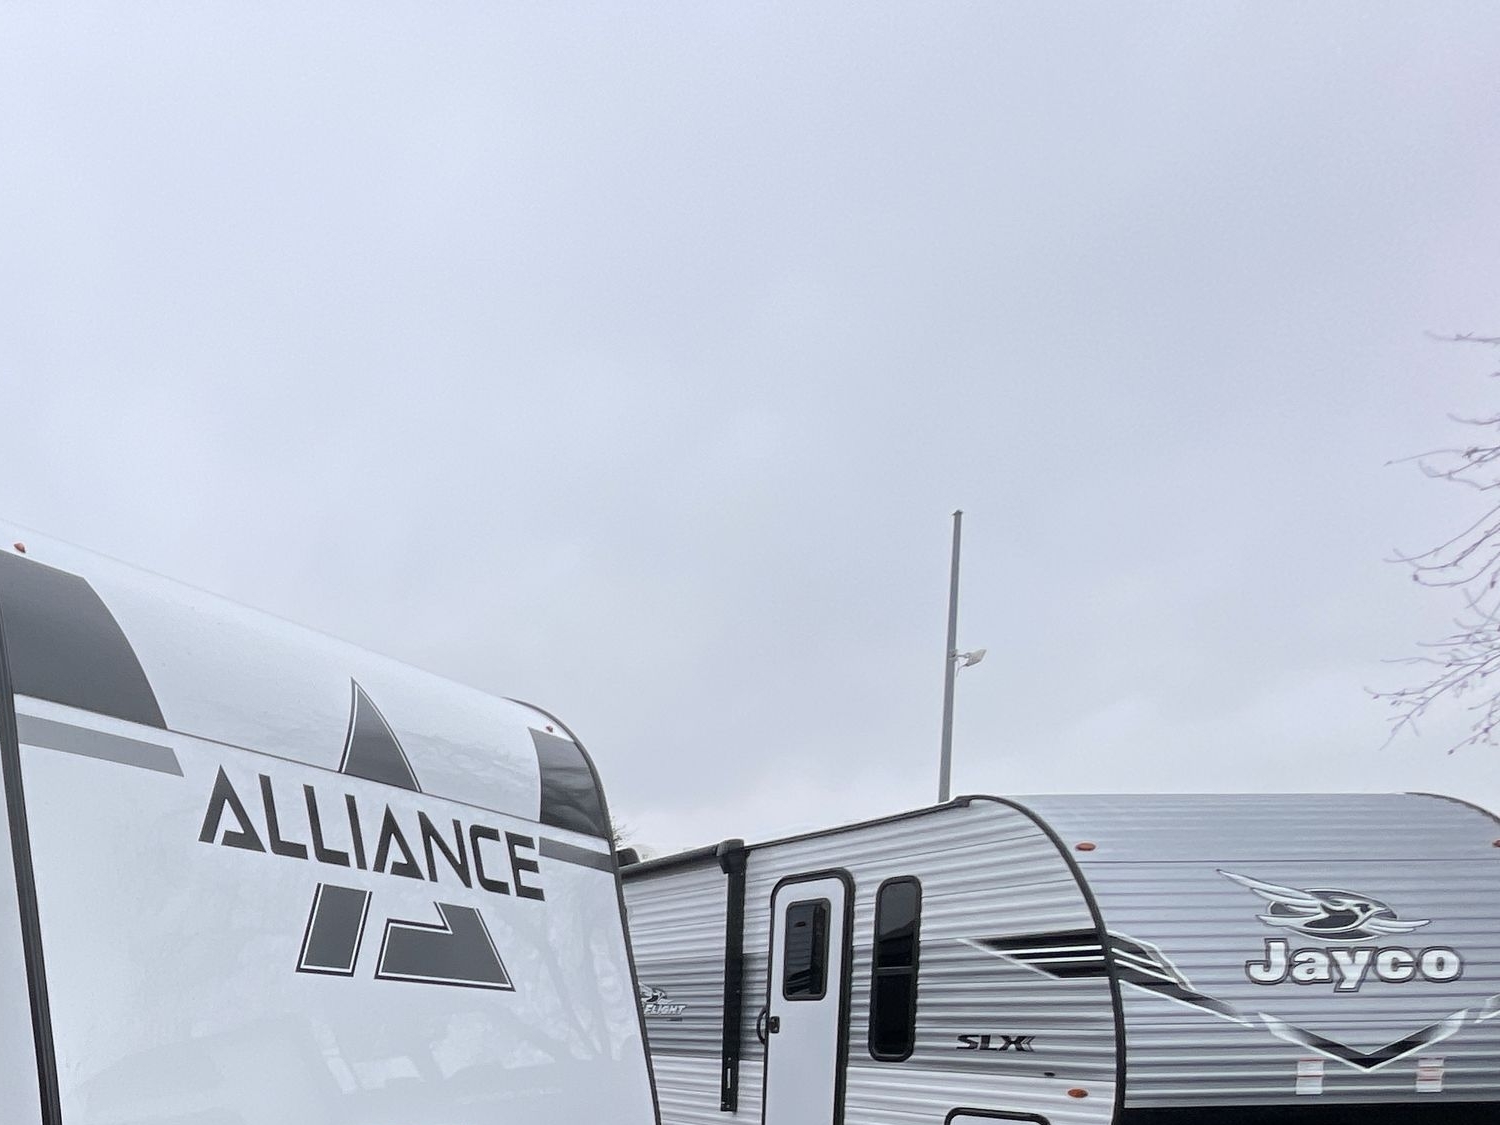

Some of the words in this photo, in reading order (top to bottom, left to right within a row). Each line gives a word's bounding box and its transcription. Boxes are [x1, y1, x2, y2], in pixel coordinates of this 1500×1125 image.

[198, 764, 545, 901] ALLIANCE
[1245, 938, 1463, 992] Jayco
[956, 1034, 1030, 1051] SLX
